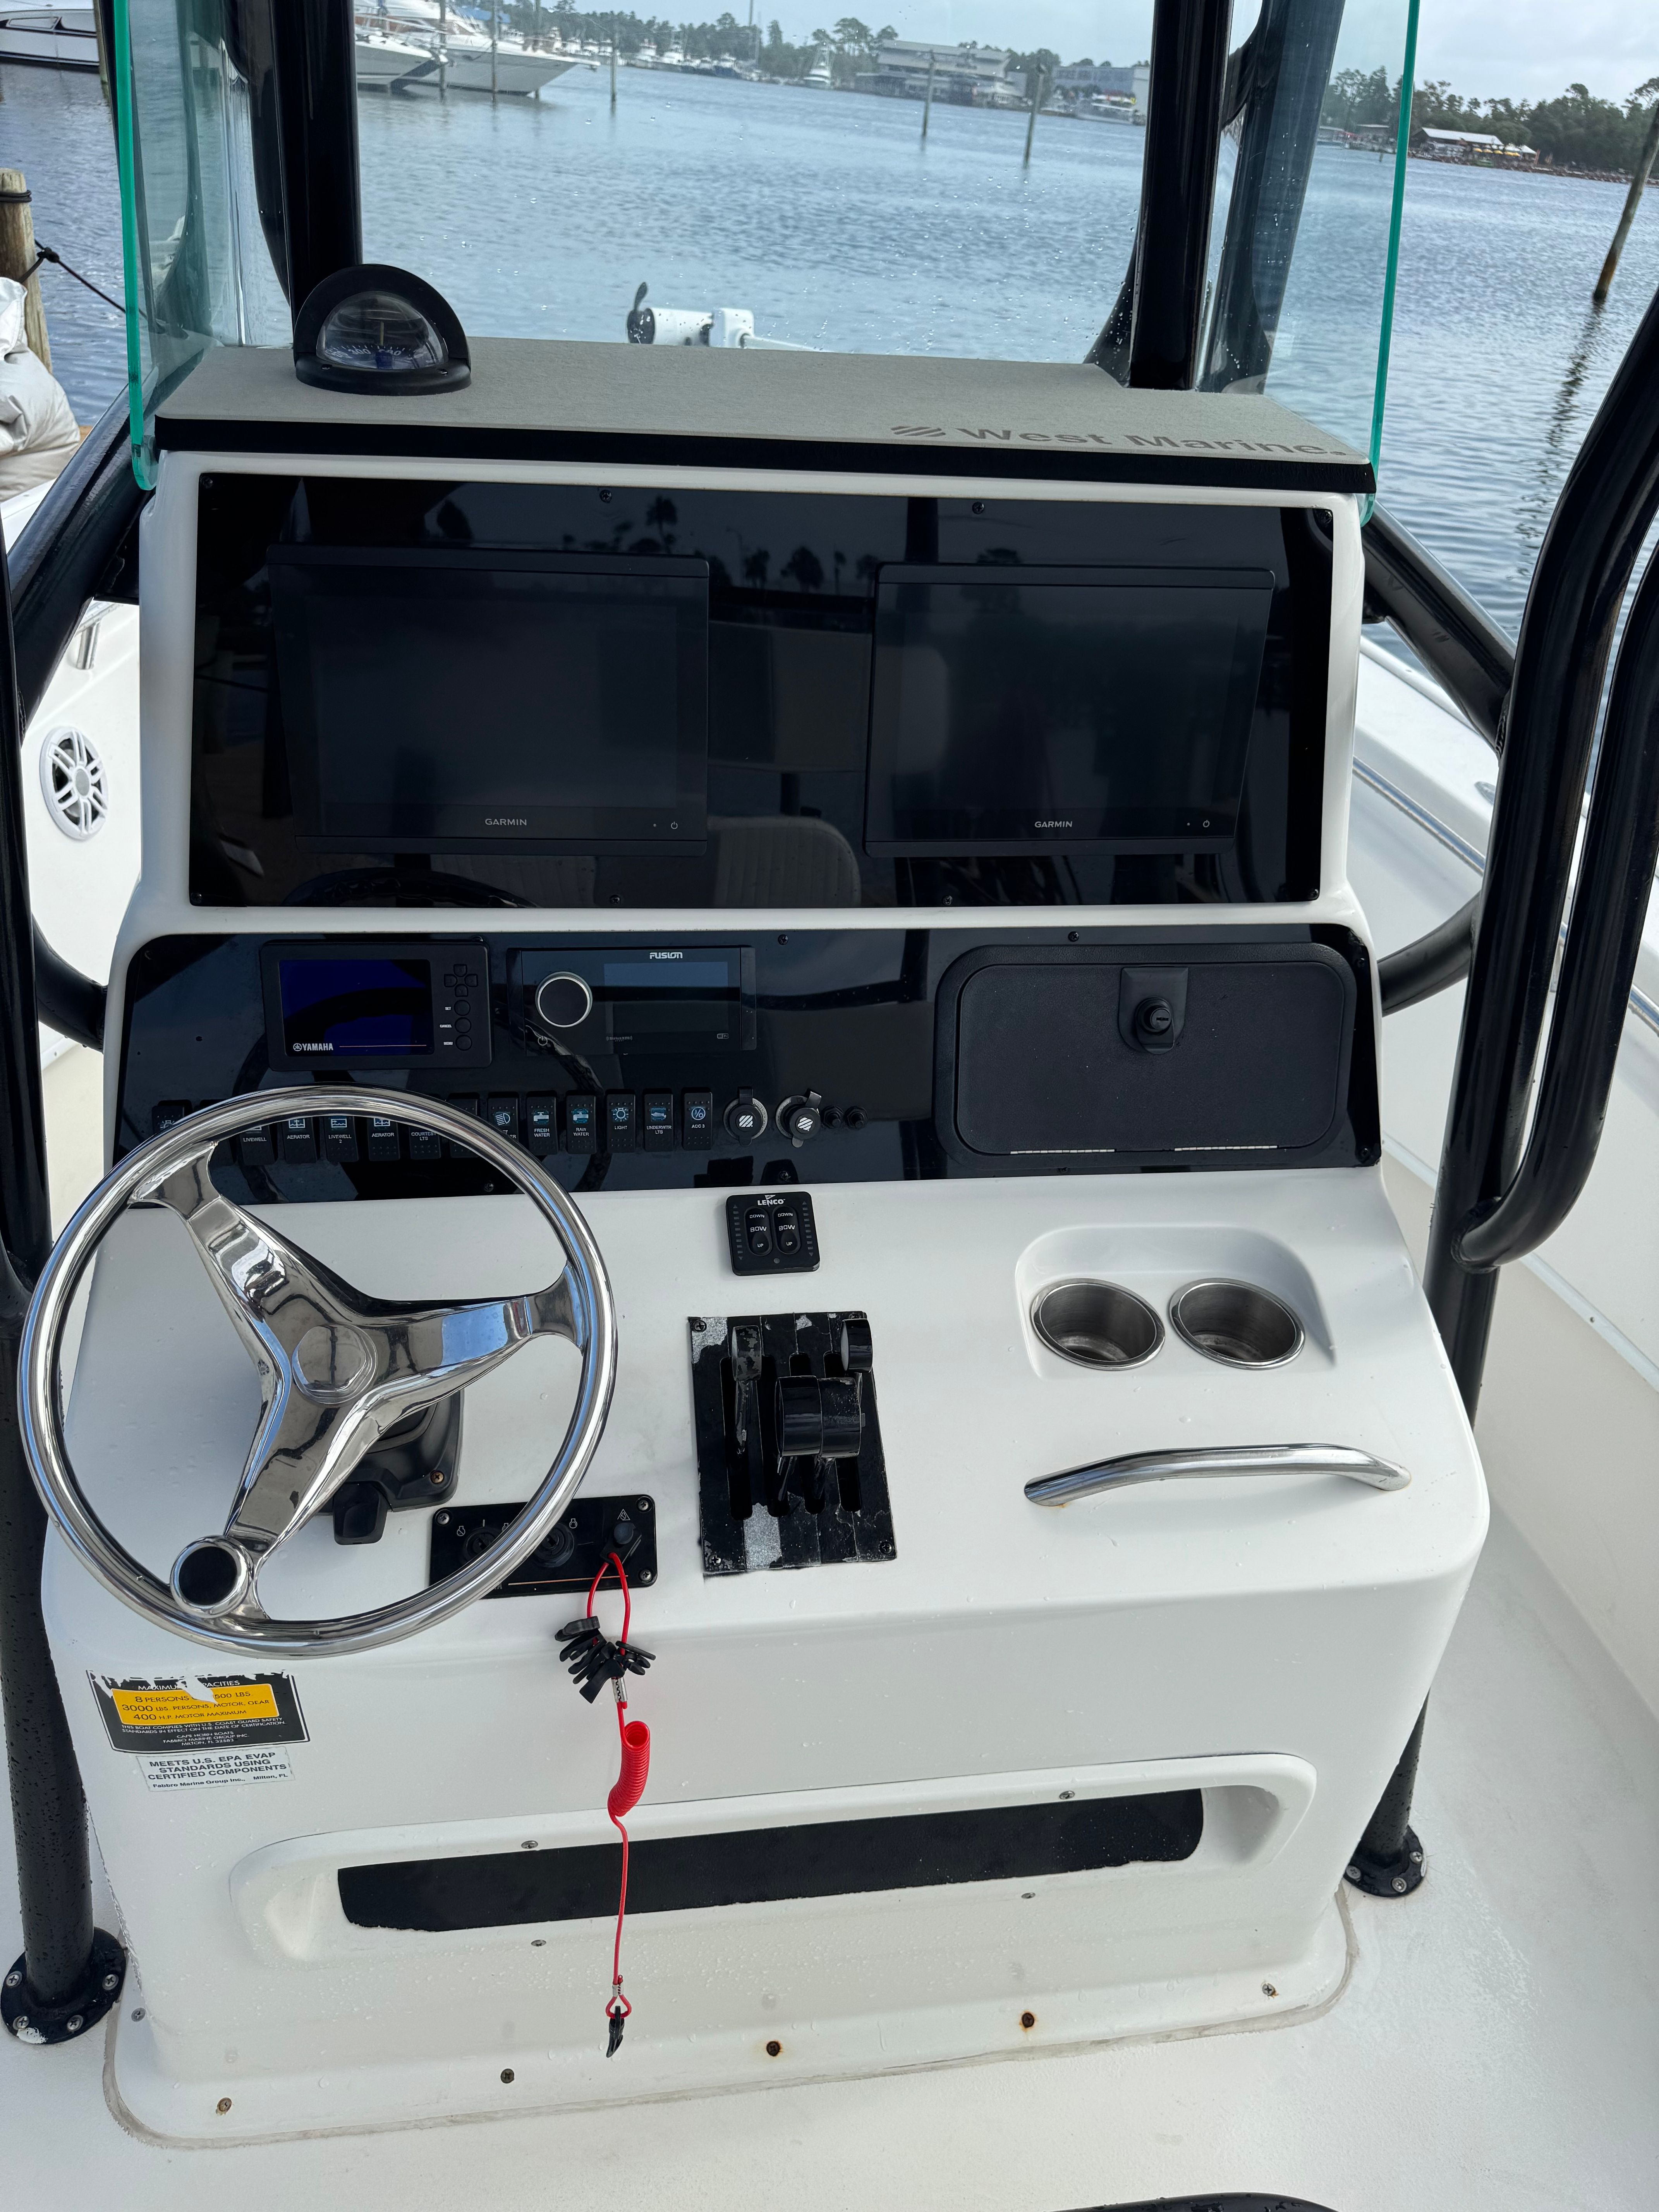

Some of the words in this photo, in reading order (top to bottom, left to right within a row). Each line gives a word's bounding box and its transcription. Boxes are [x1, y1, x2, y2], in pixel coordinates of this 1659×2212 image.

[953, 427, 1113, 445] West
[148, 1771, 206, 1780] CERTIFIED
[208, 1764, 287, 1776] COMPONENTS
[159, 1762, 231, 1773] STANDARDS
